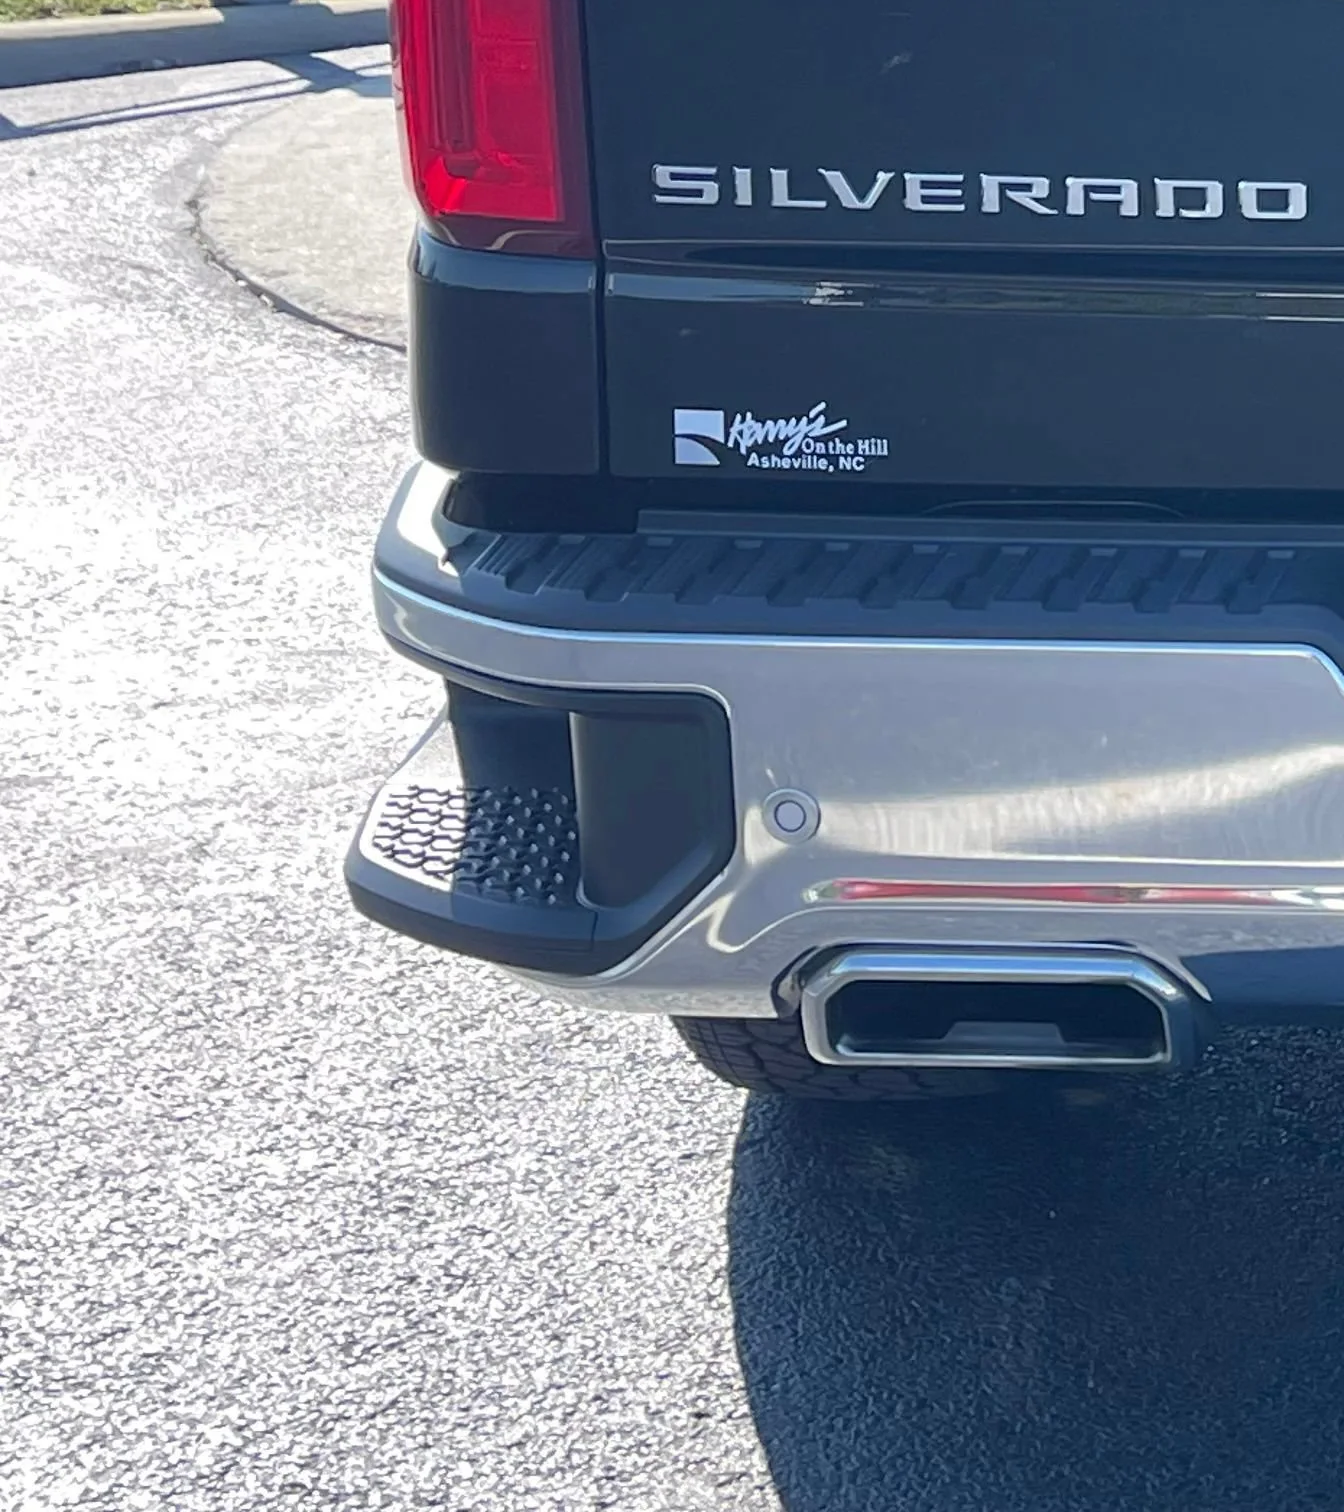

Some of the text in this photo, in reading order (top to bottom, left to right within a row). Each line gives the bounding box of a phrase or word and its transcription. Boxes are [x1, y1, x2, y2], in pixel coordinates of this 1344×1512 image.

[651, 163, 1308, 220] SILVERADO
[727, 401, 848, 456] Harry's
[802, 438, 888, 456] On the Hill
[746, 452, 865, 473] Asheville, NC
